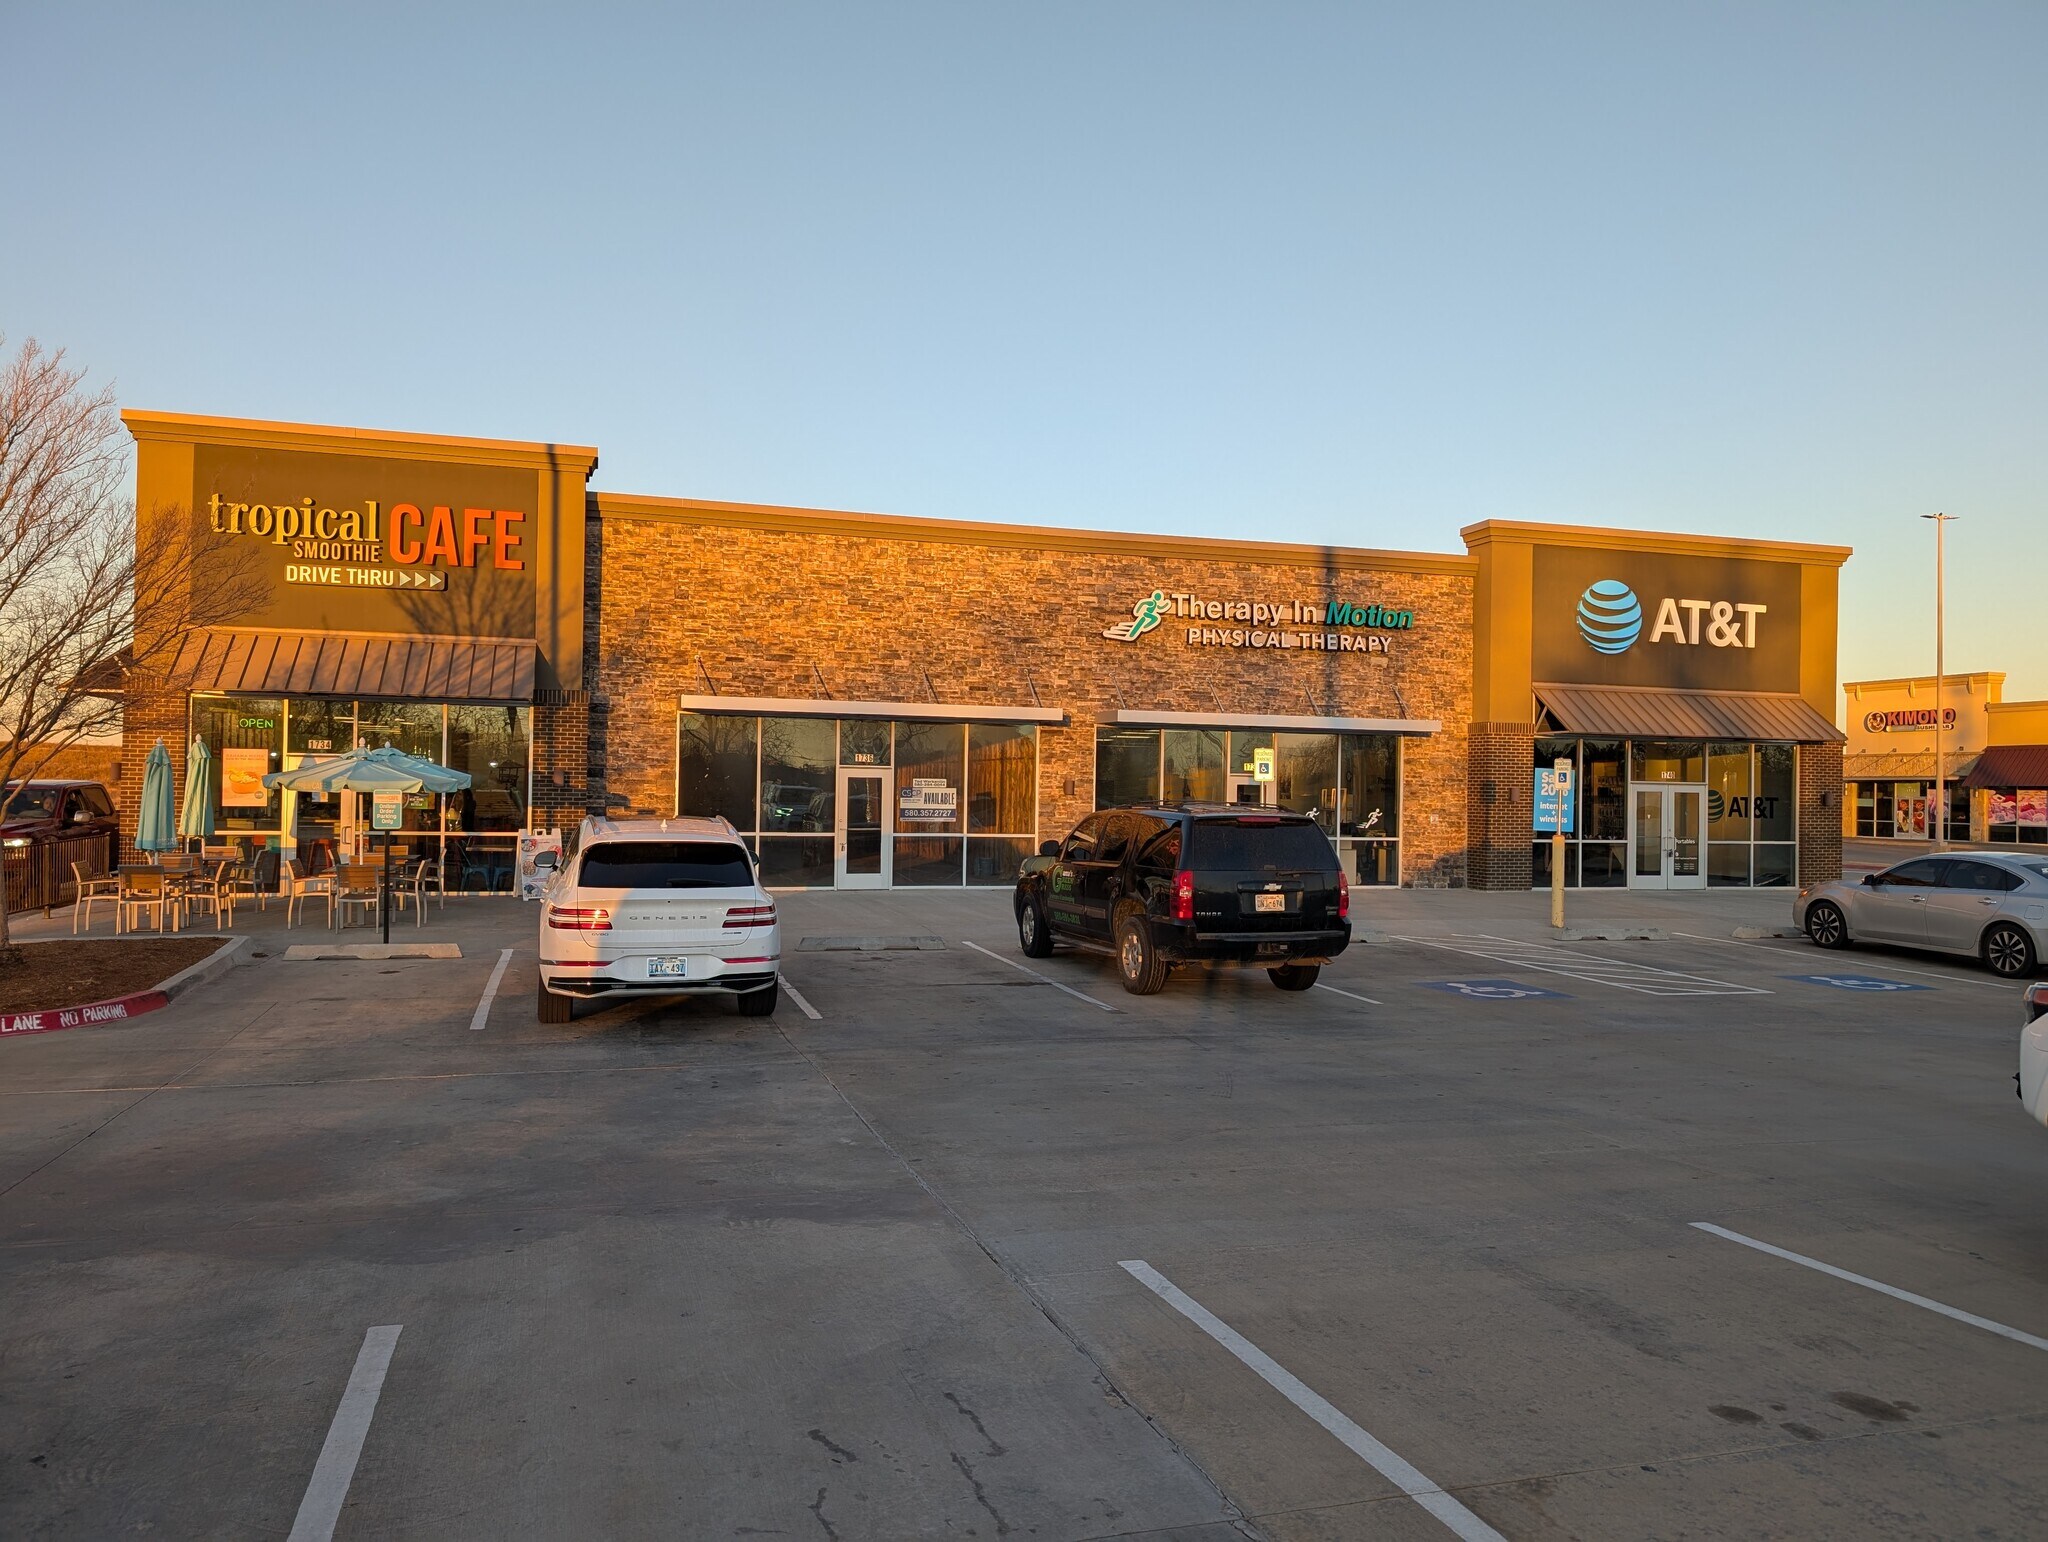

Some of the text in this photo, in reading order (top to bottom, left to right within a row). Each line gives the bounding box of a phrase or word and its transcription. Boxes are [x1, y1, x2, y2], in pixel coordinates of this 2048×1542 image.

[208, 493, 380, 545] tropical
[389, 503, 525, 570] CAFE
[293, 540, 381, 563] SMOOTHIE
[286, 565, 394, 587] DRIVE THRU
[1171, 593, 1413, 629] Therapy In Motion
[1649, 598, 1767, 649] AT&T
[1187, 628, 1393, 652] PHYSICAL THERAPY
[239, 718, 274, 729] OPEN
[1887, 709, 1955, 726] KIMONO
[309, 740, 331, 749] 1734
[856, 754, 873, 763] 1736
[923, 792, 955, 806] AVAILABLE
[1727, 796, 1780, 819] AT&T
[904, 809, 952, 817] 580.357.2727
[1, 1003, 128, 1033] LANE NO PARKING
